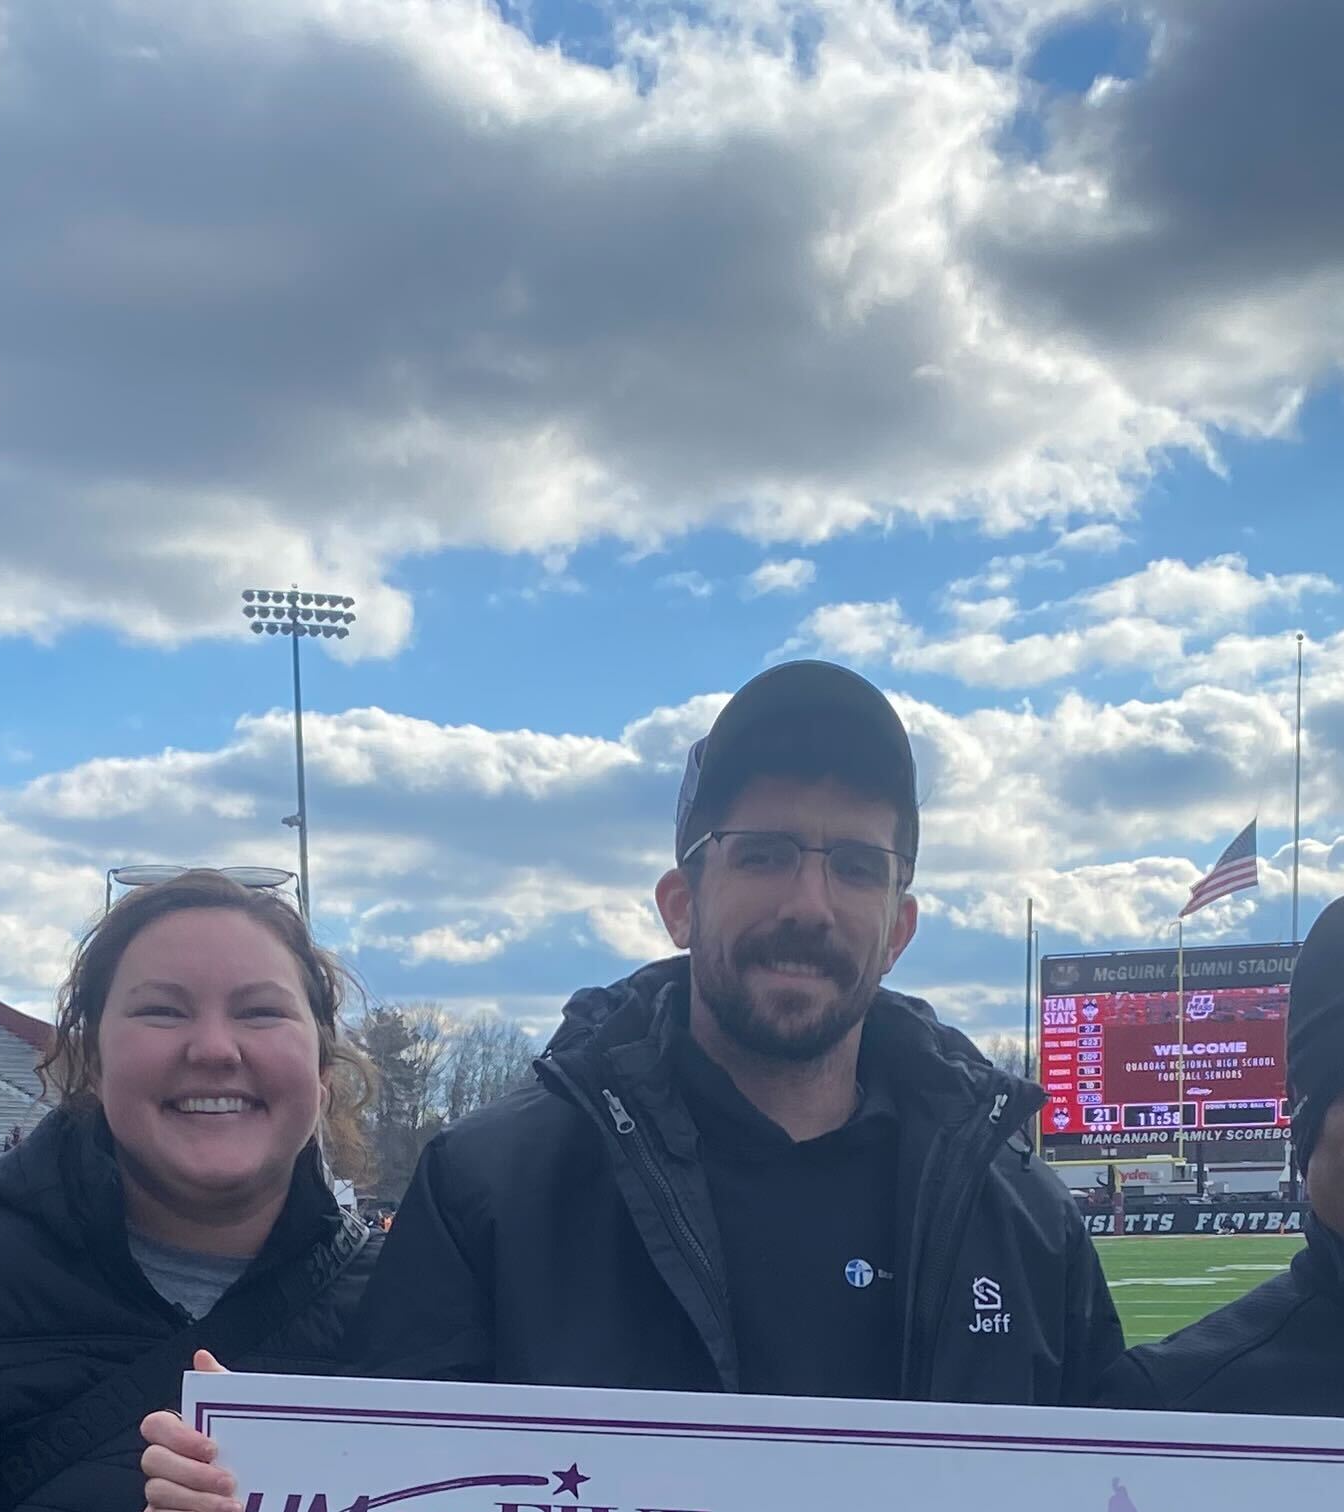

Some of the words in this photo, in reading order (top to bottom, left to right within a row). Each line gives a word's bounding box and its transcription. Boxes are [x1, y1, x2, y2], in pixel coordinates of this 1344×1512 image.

[1093, 964, 1166, 981] McGUIRK
[1171, 960, 1233, 977] ALUMNI
[1238, 957, 1298, 974] STADIU
[1044, 998, 1076, 1011] TEAM
[1043, 1011, 1077, 1025] STATS
[1154, 1041, 1247, 1056] WELCOME
[1216, 1058, 1238, 1068] HIGH
[1242, 1057, 1276, 1066] SCHOOL
[1158, 1071, 1201, 1082] FOOTBALL
[1205, 1070, 1243, 1080] SENIORS
[1093, 1109, 1111, 1122] 21
[1138, 1111, 1181, 1127] 11:58
[1081, 1132, 1168, 1145] MANGANARO
[1173, 1129, 1222, 1142] FAMILY
[1226, 1128, 1292, 1141] SCOREBO
[969, 1313, 1010, 1333] Jeff
